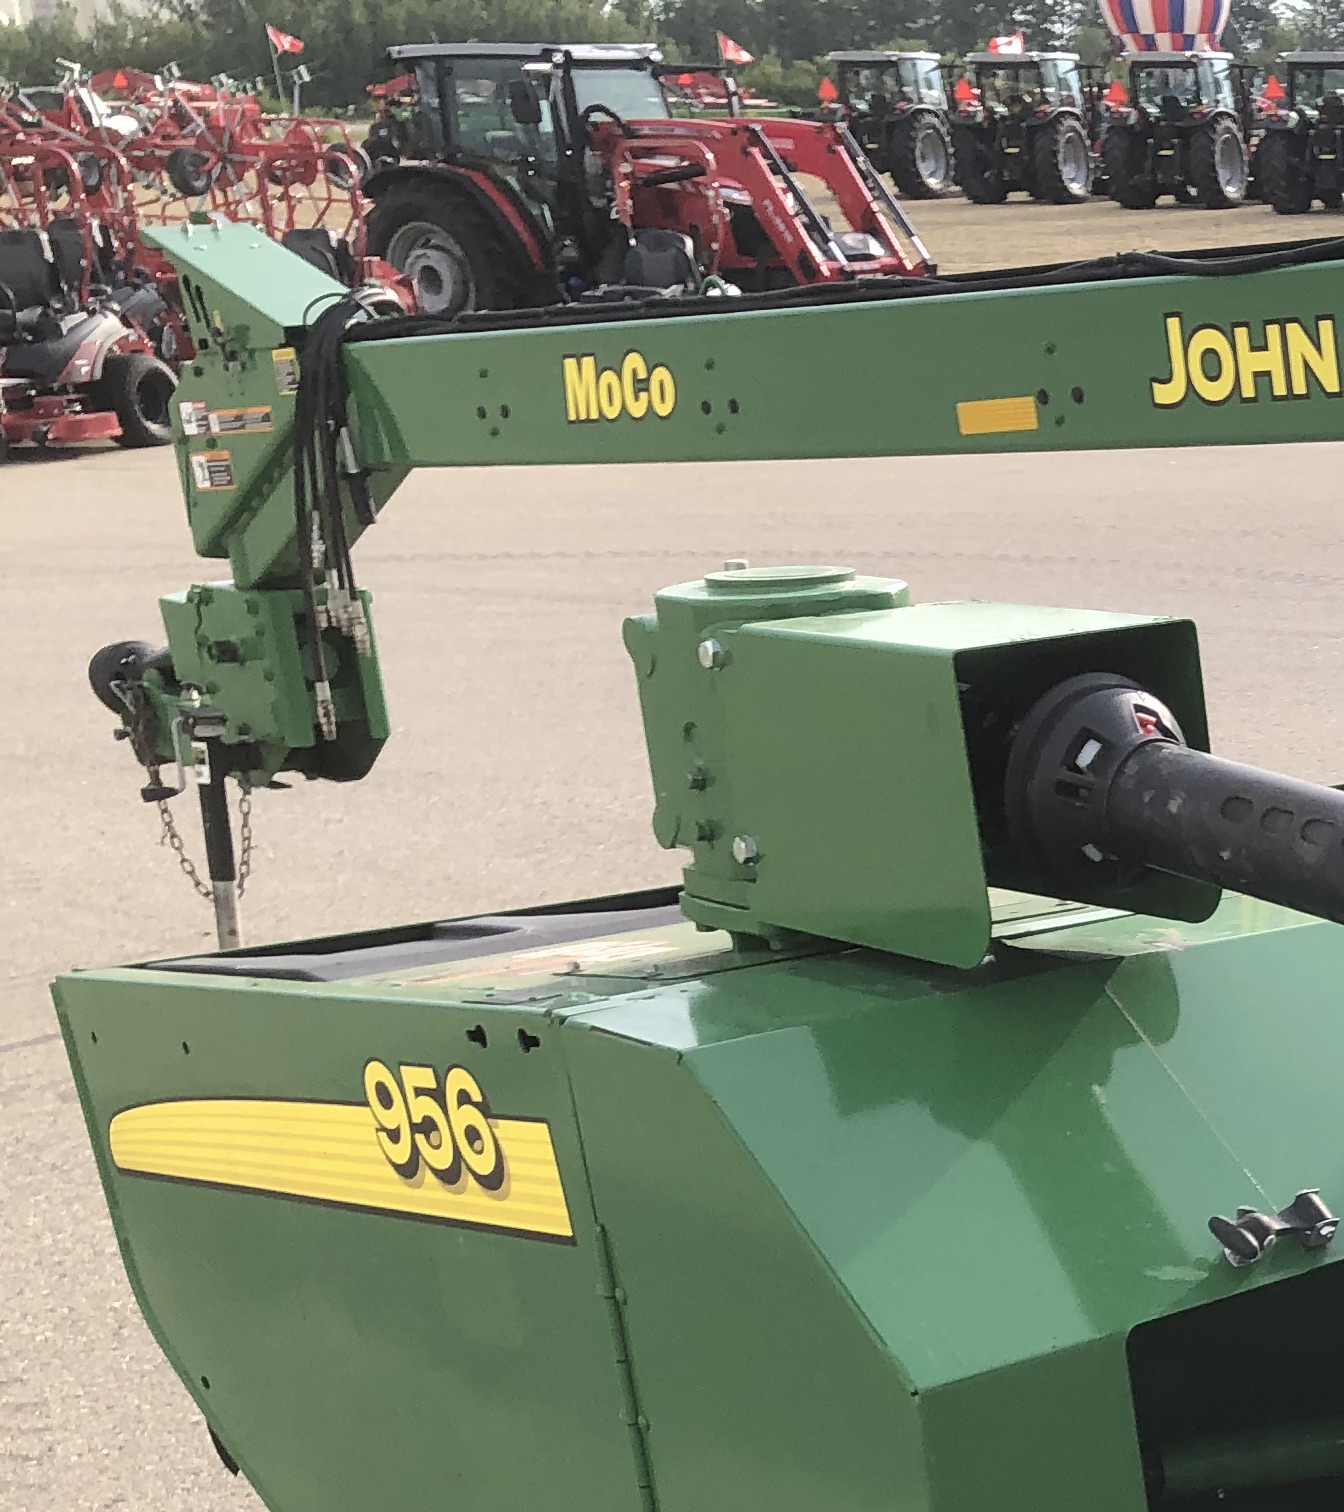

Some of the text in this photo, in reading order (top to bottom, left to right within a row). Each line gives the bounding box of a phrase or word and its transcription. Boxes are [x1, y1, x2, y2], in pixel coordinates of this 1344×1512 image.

[563, 350, 676, 423] MoCo
[1151, 313, 1341, 407] JOHN
[363, 1058, 505, 1192] 956
